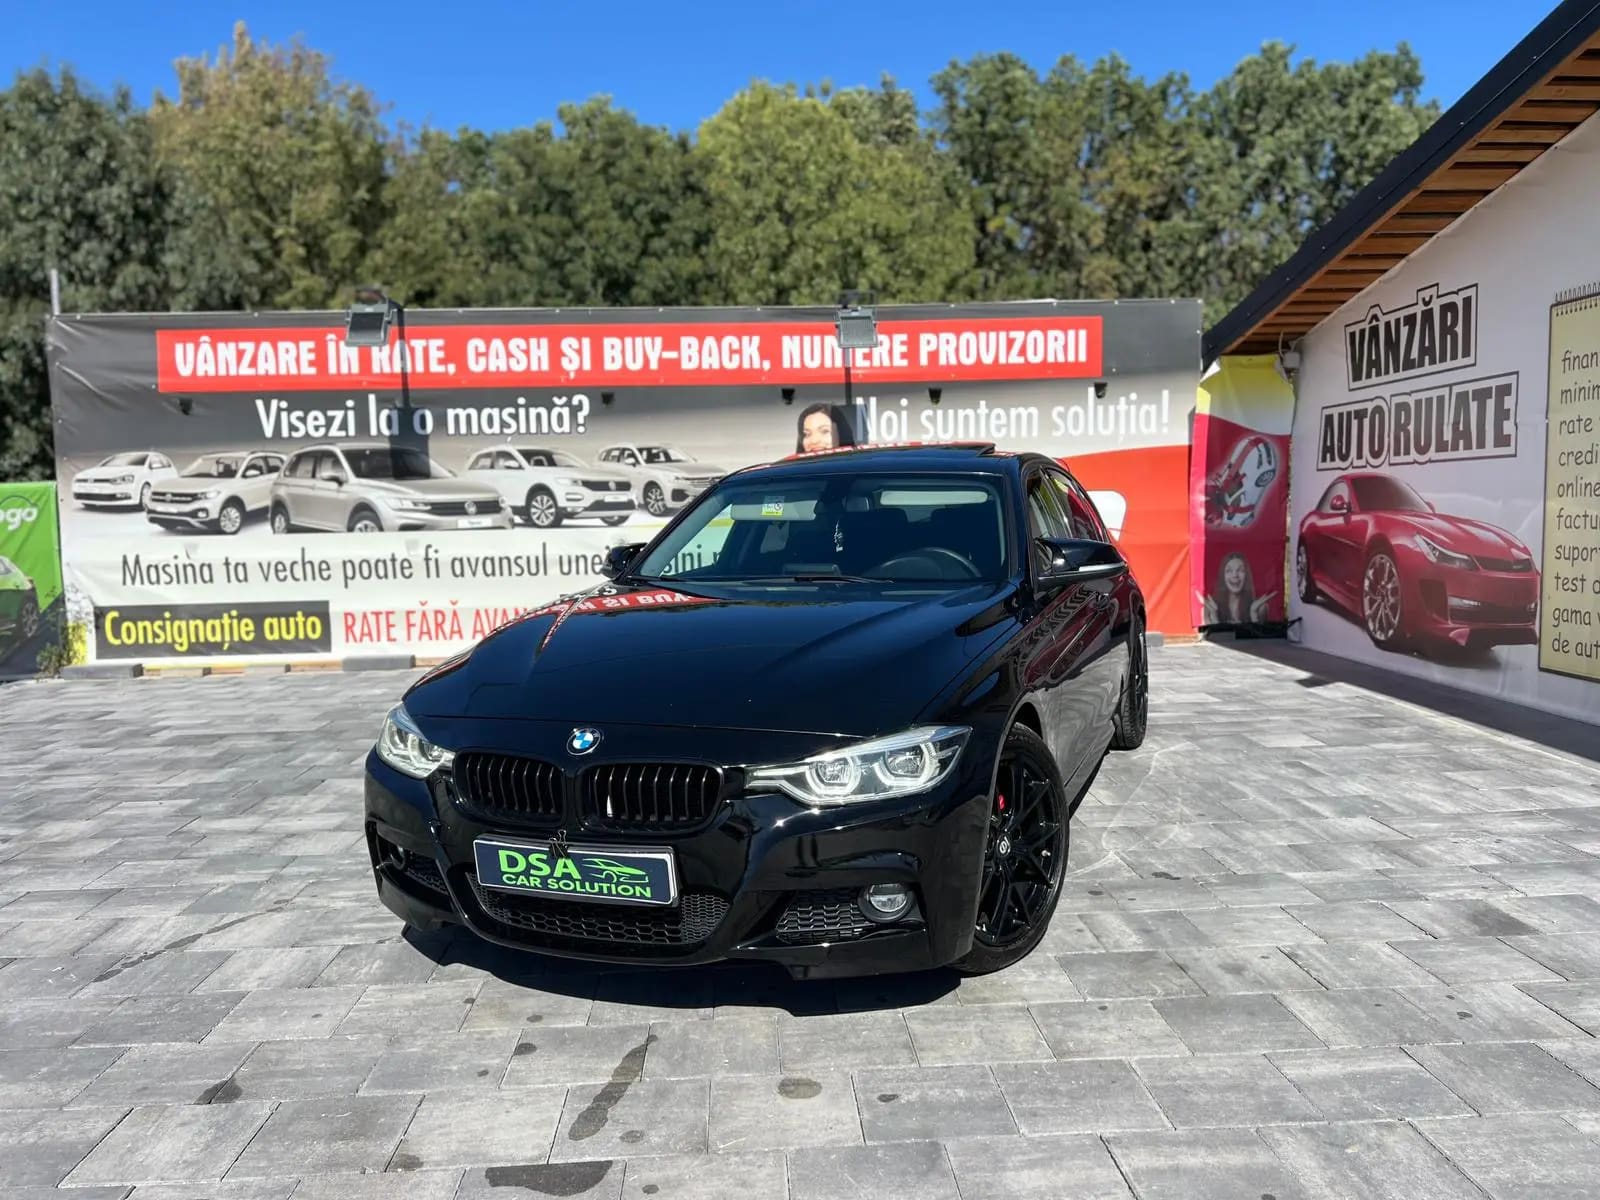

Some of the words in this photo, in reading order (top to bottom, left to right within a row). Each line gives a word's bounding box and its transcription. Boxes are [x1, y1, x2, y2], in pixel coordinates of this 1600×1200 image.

[1349, 294, 1472, 383] VÂNZĂRI
[174, 335, 317, 377] VÂNZARE
[325, 333, 360, 375] ÎN
[371, 338, 456, 376] RATE,
[466, 337, 549, 373] CASH
[560, 336, 591, 380] ȘI
[603, 335, 771, 371] BUY-BACK,
[919, 329, 1087, 366] PROVIZORII
[1562, 350, 1600, 374] finan
[255, 398, 356, 438] Visezi
[368, 393, 400, 436] la
[412, 408, 434, 435] o
[856, 395, 908, 441] Noi
[920, 400, 1039, 441] suntem
[1051, 385, 1170, 443] soluția!
[1321, 404, 1386, 464] AUTO
[1392, 383, 1512, 457] RULATE
[1559, 414, 1593, 436] rate
[1557, 475, 1600, 498] online
[1556, 507, 1600, 531] factu
[223, 556, 249, 584] ta
[258, 547, 332, 582] veche
[342, 552, 413, 589] poate
[423, 544, 441, 579] fi
[451, 542, 548, 578] avansul
[559, 545, 610, 576] une
[1554, 544, 1600, 567] supor
[1554, 572, 1587, 593] test
[104, 609, 255, 651] Consignație
[263, 611, 322, 641] auto
[343, 610, 398, 644] RATE
[405, 600, 465, 642] FĂRĂ
[1552, 607, 1592, 628] gama
[1552, 632, 1570, 654] de
[498, 849, 582, 880] DSA
[502, 874, 543, 888] CAR
[547, 878, 652, 898] SOLUTION
